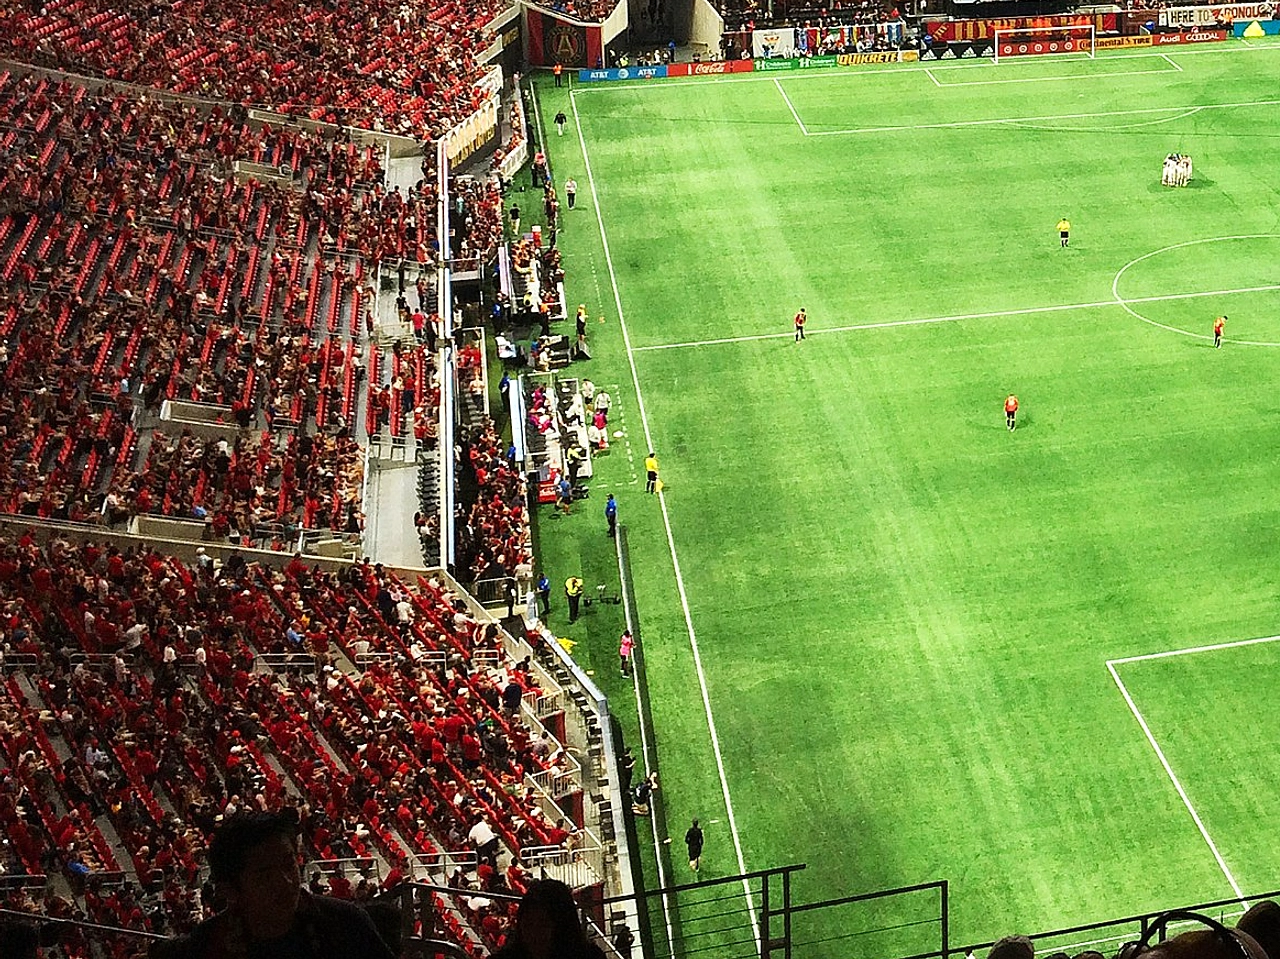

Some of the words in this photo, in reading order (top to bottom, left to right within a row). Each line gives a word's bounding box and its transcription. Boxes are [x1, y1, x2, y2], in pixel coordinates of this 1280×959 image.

[1170, 10, 1194, 23] HERE
[1196, 9, 1210, 22] TO
[1160, 35, 1181, 43] Audi
[838, 52, 899, 66] QUIKRETE
[590, 71, 609, 79] AT&T
[638, 68, 657, 76] AT&T
